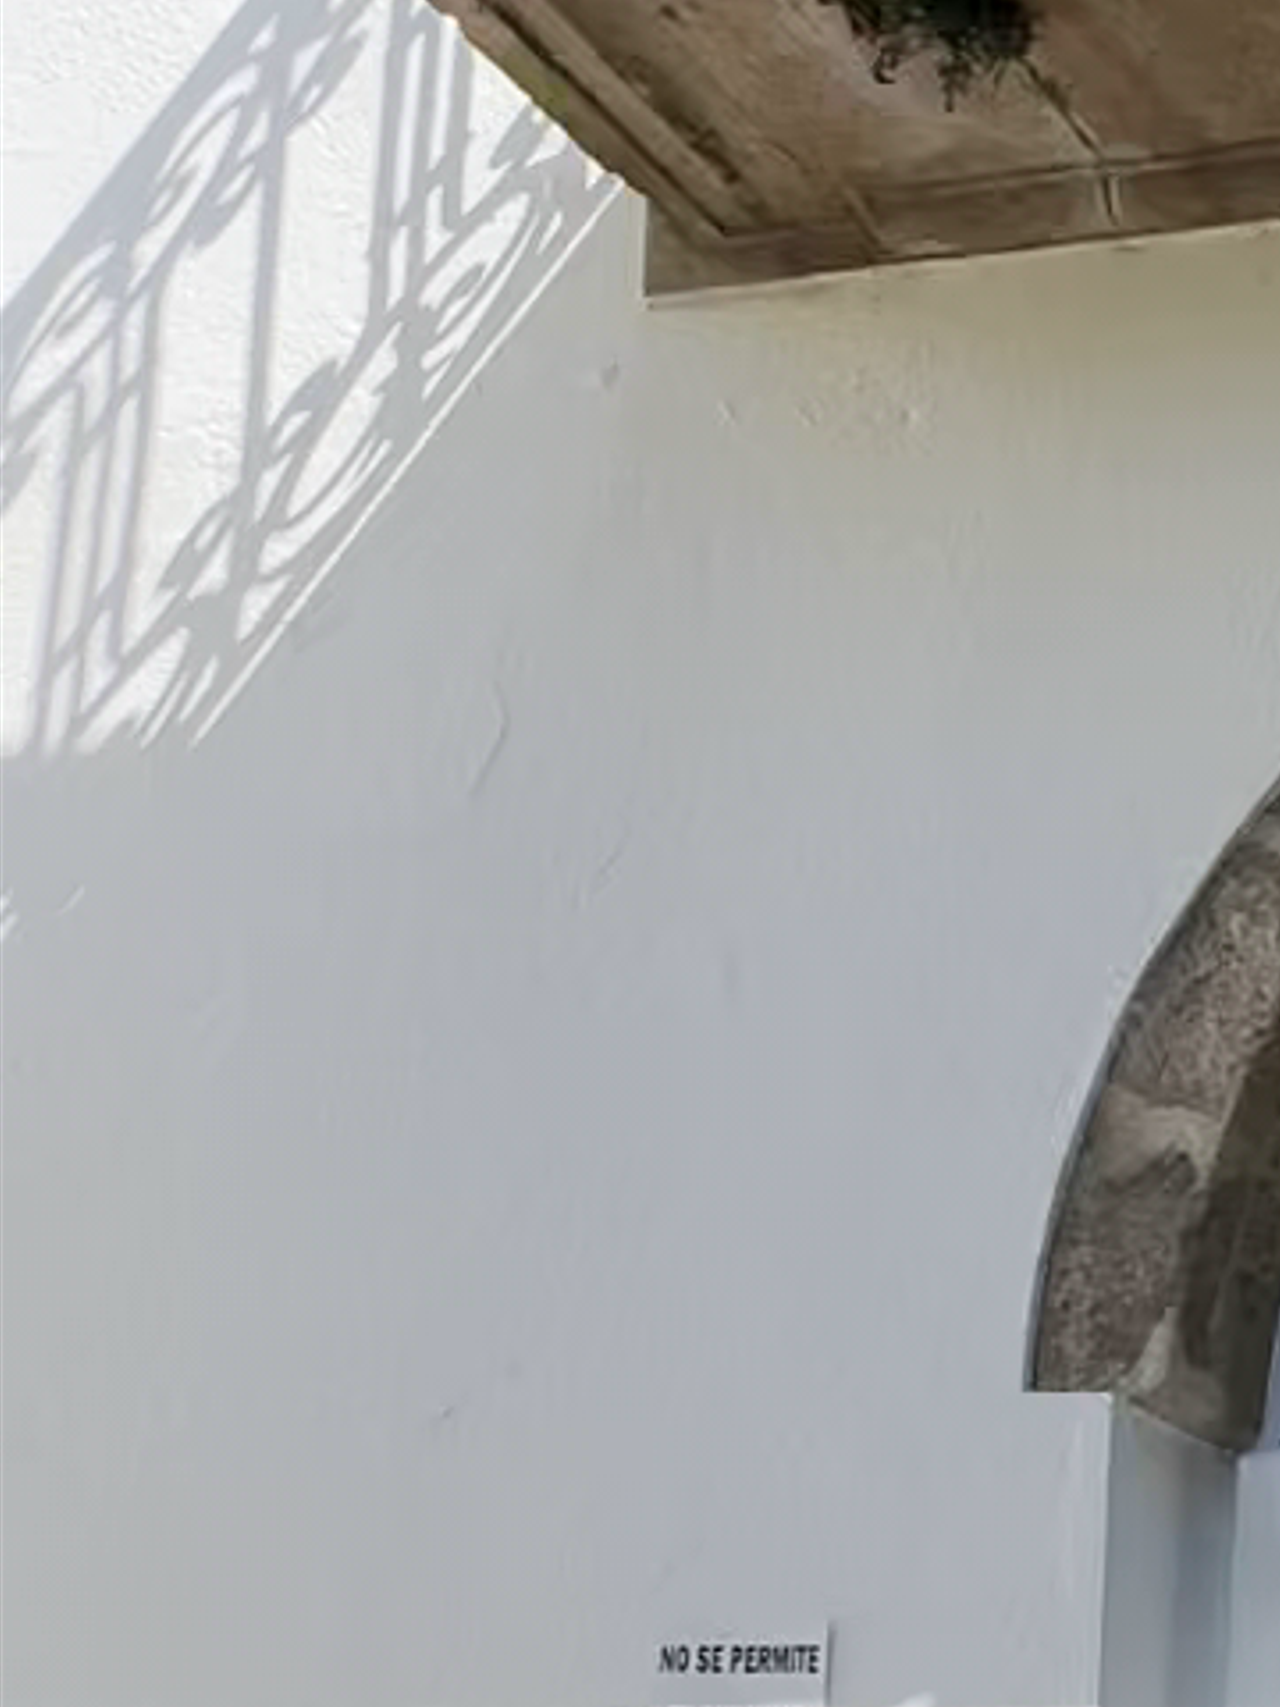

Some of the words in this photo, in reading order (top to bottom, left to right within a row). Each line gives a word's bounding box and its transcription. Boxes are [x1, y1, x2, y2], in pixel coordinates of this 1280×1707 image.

[659, 1645, 690, 1674] NO
[695, 1645, 724, 1674] SE
[730, 1645, 820, 1674] PERMITE
